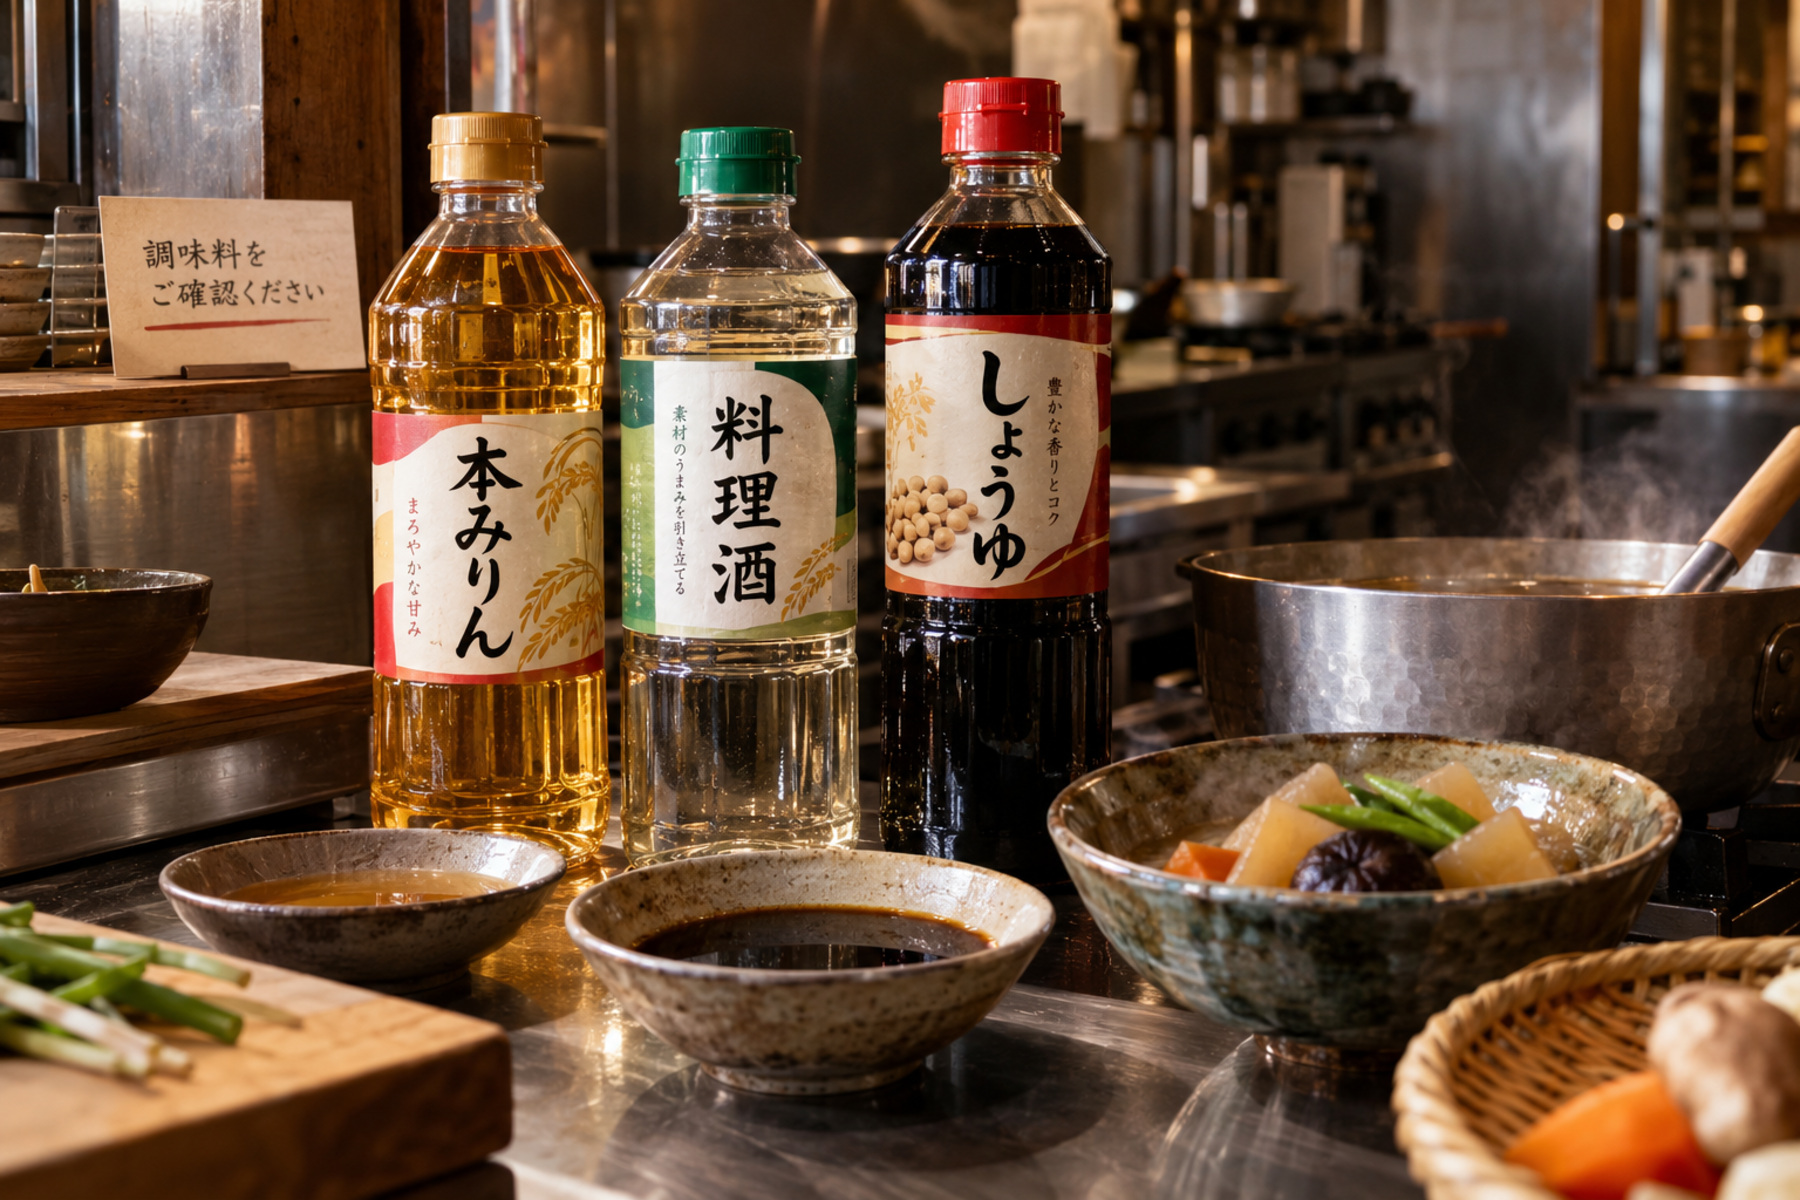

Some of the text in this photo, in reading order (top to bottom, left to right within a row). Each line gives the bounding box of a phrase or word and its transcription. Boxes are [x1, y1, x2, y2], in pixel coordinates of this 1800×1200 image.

[143, 238, 266, 270] 調味料を
[153, 279, 325, 309] ご確認ください
[710, 394, 783, 605] 料理酒
[973, 350, 1030, 581] しょうゆ
[1047, 376, 1063, 527] 豊かな香りとコク
[407, 497, 422, 637] まろやかな甘み
[449, 436, 523, 659] 本みりん
